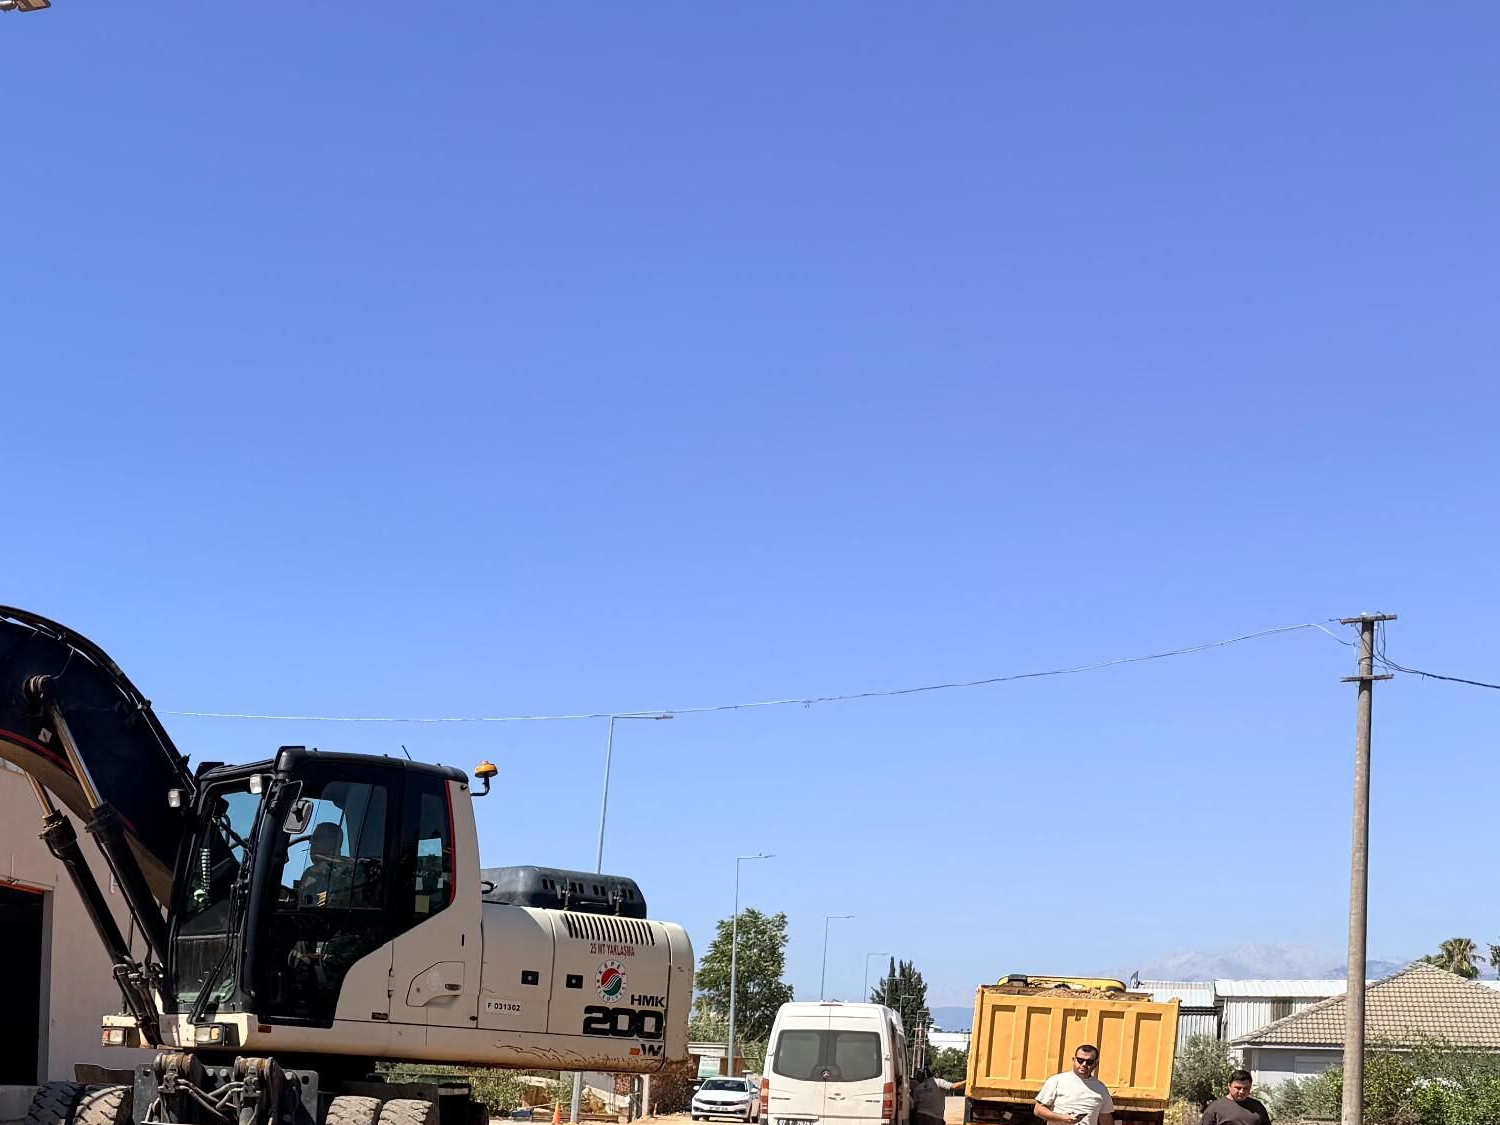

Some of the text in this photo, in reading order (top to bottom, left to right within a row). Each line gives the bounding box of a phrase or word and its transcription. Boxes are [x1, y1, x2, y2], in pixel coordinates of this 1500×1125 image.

[590, 942, 597, 954] 25
[494, 1002, 520, 1012] 031302
[630, 994, 666, 1008] HMK
[583, 1005, 664, 1039] 200
